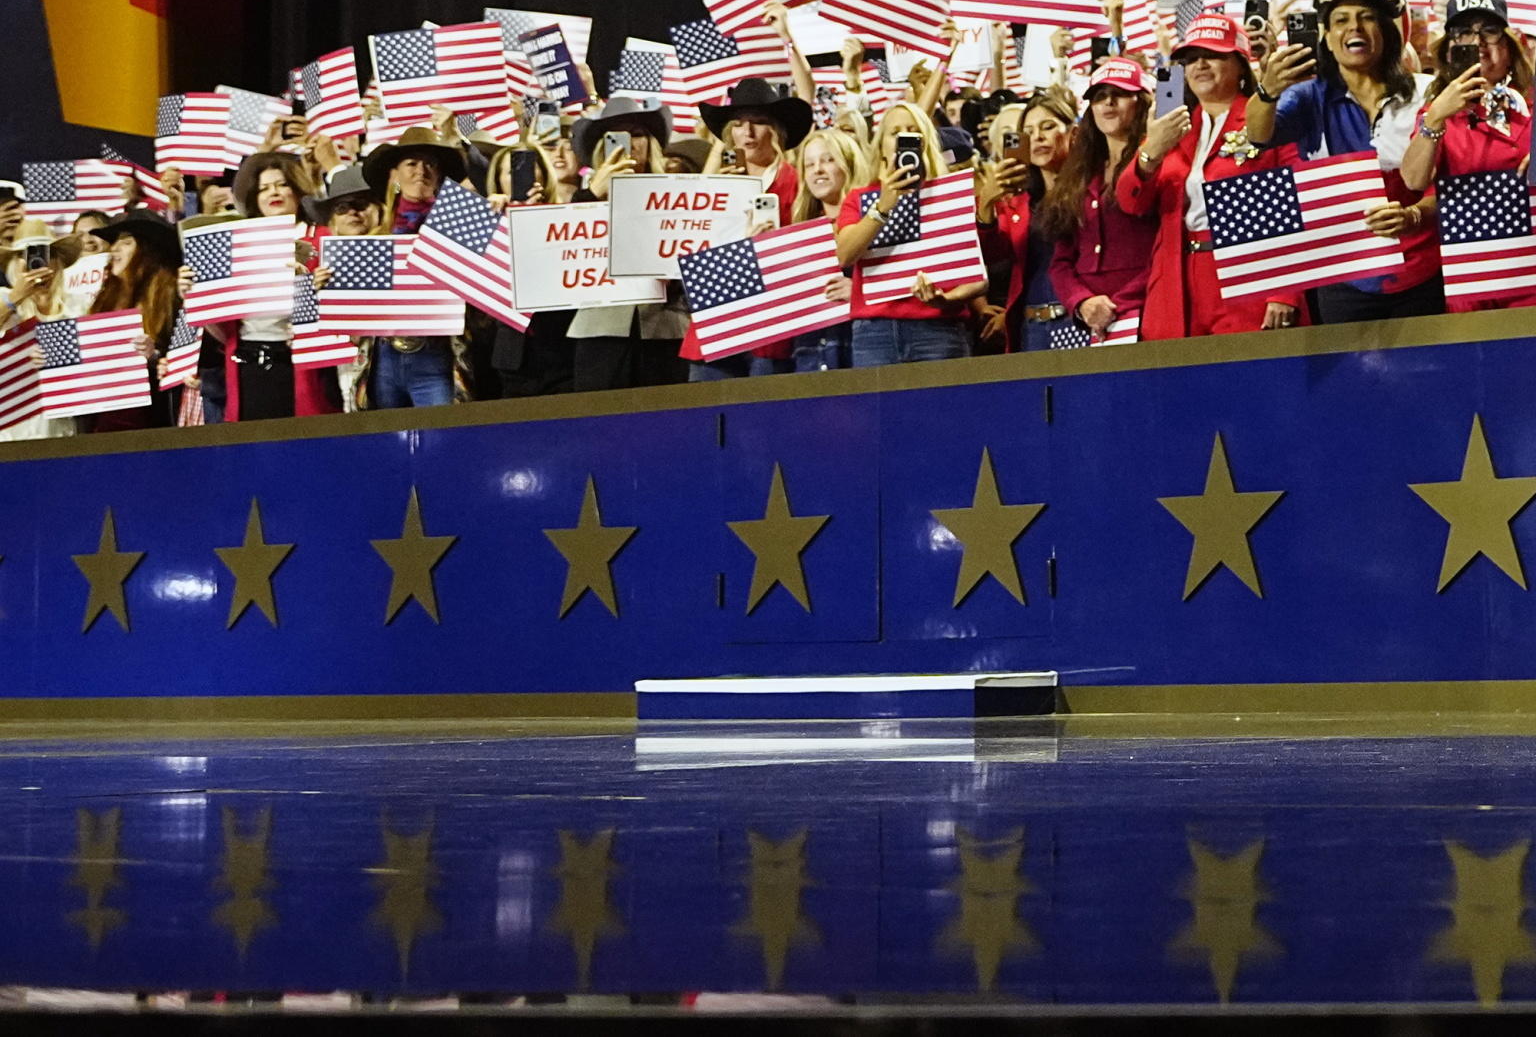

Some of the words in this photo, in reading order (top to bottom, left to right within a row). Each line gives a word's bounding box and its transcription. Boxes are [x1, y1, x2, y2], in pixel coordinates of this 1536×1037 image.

[1200, 29, 1224, 40] AGAIN
[645, 192, 729, 211] MADE
[546, 220, 609, 242] MAD
[660, 219, 677, 230] IN
[681, 219, 712, 231] THE
[561, 249, 578, 261] IN
[562, 267, 616, 289] USA
